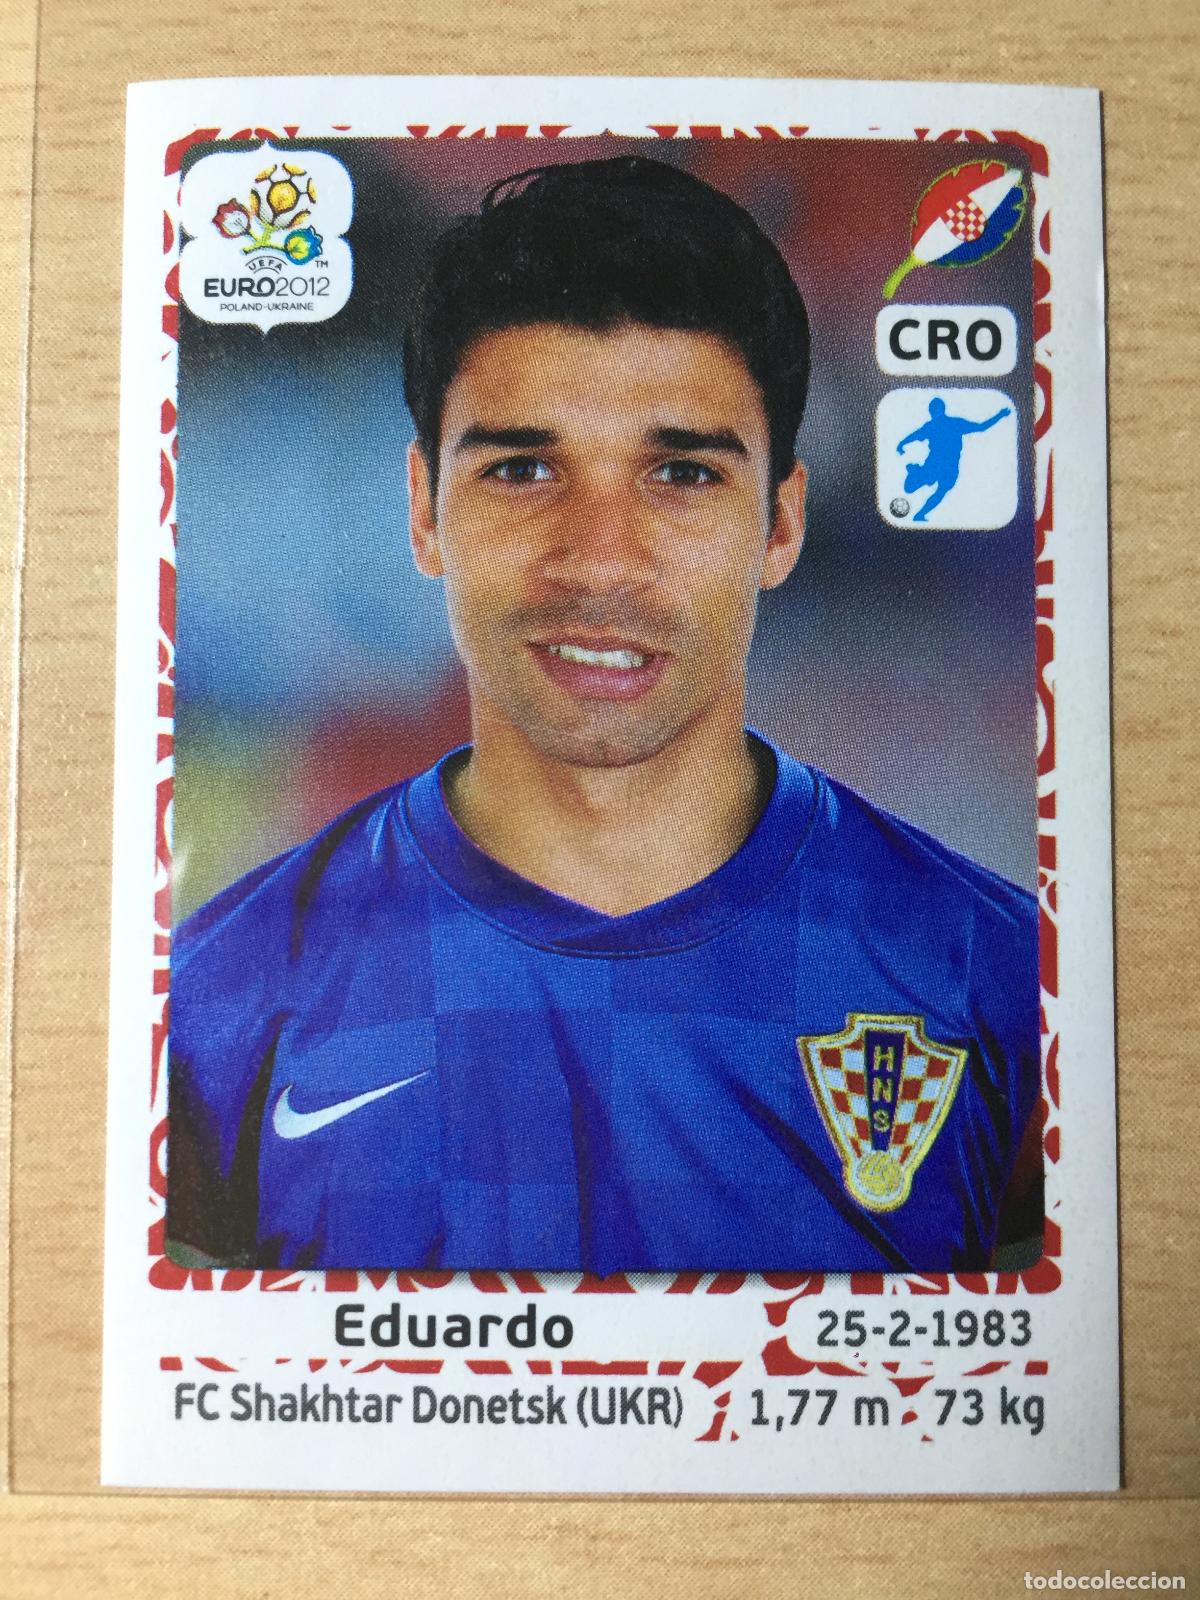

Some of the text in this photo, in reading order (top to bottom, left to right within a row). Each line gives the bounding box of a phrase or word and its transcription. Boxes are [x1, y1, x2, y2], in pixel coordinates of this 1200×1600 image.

[248, 259, 283, 272] UEFA
[315, 260, 329, 268] TM
[204, 277, 330, 297] EURO2012
[219, 302, 314, 311] POLAND-UKRAINE
[889, 319, 1002, 361] CRO
[334, 1303, 574, 1348] Eduardo
[816, 1310, 1032, 1347] 25-2-1983
[174, 1383, 683, 1429] FC Shakhtar Donetsk (UKR)
[750, 1389, 890, 1431] 1,77 m
[934, 1387, 1046, 1435] 73 kg
